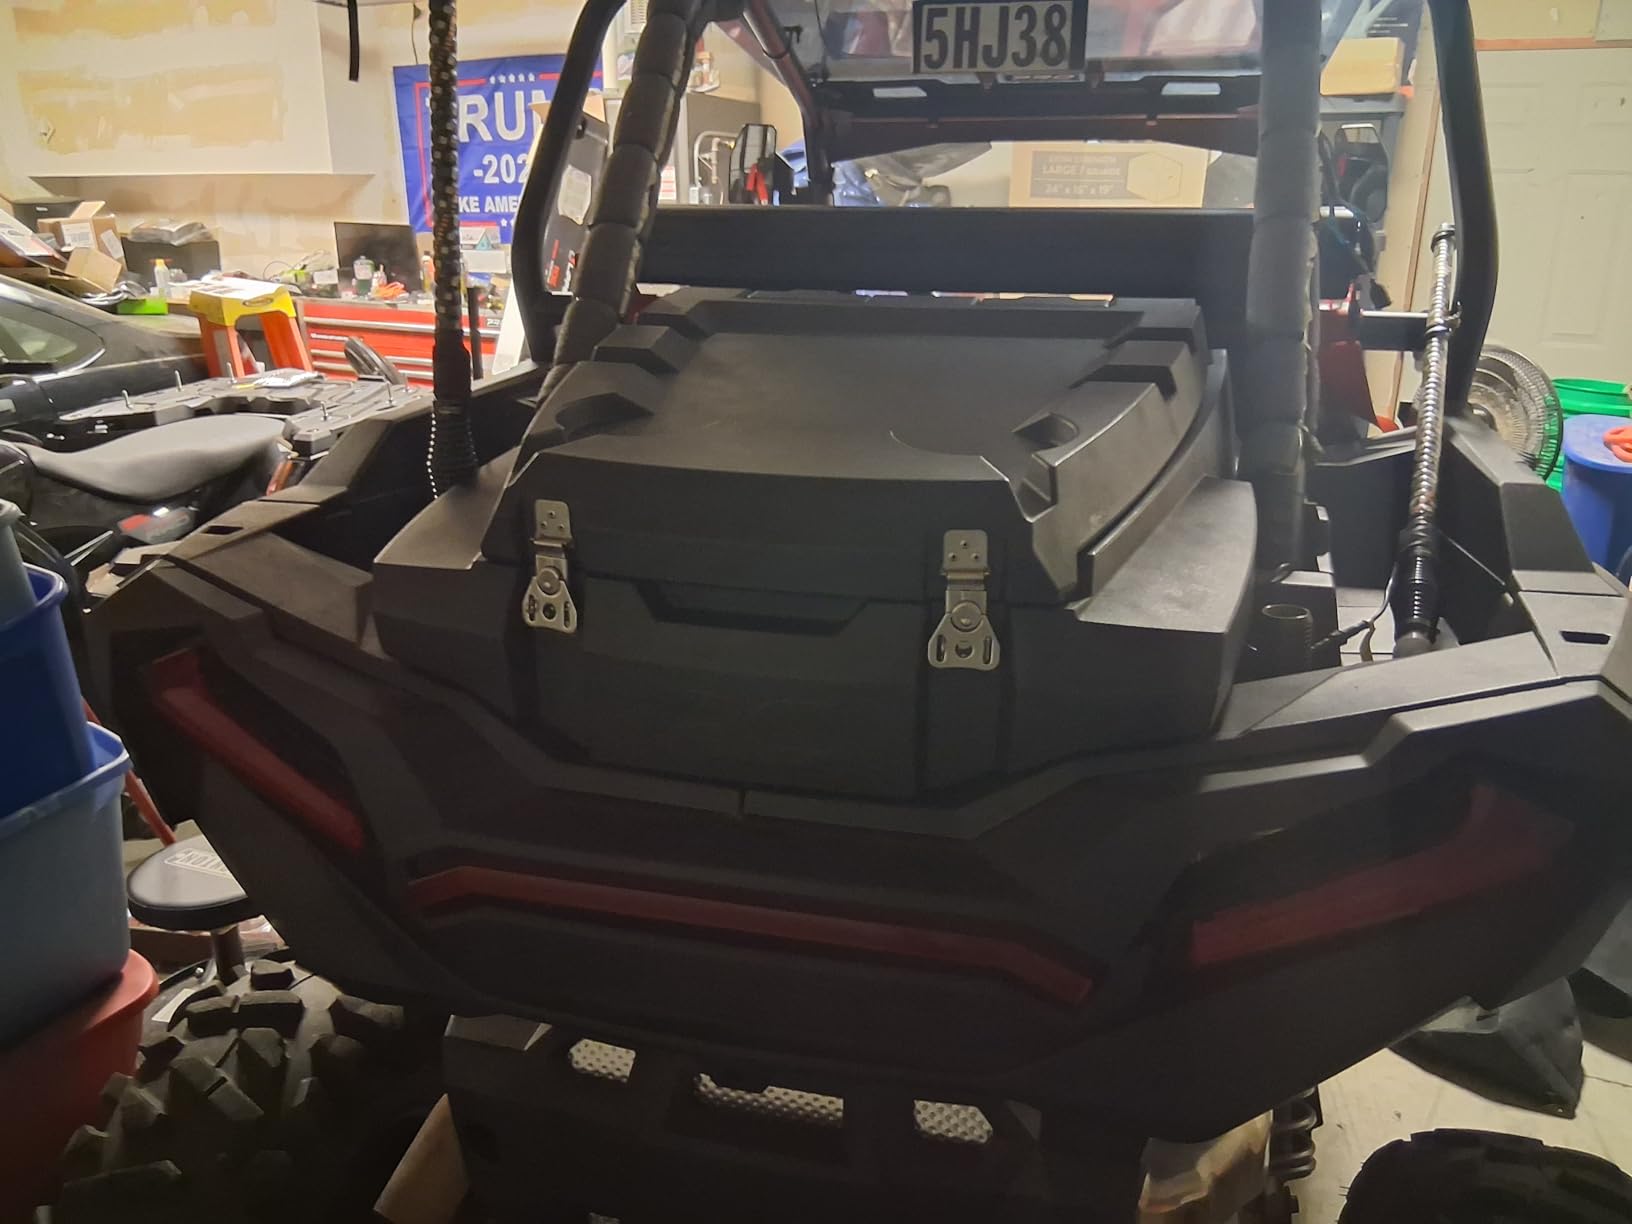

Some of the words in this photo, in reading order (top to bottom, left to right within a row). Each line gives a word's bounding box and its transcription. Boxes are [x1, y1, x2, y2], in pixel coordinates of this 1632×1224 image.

[923, 3, 1067, 70] 5HJ38
[473, 153, 531, 184] -202
[458, 195, 480, 213] KE
